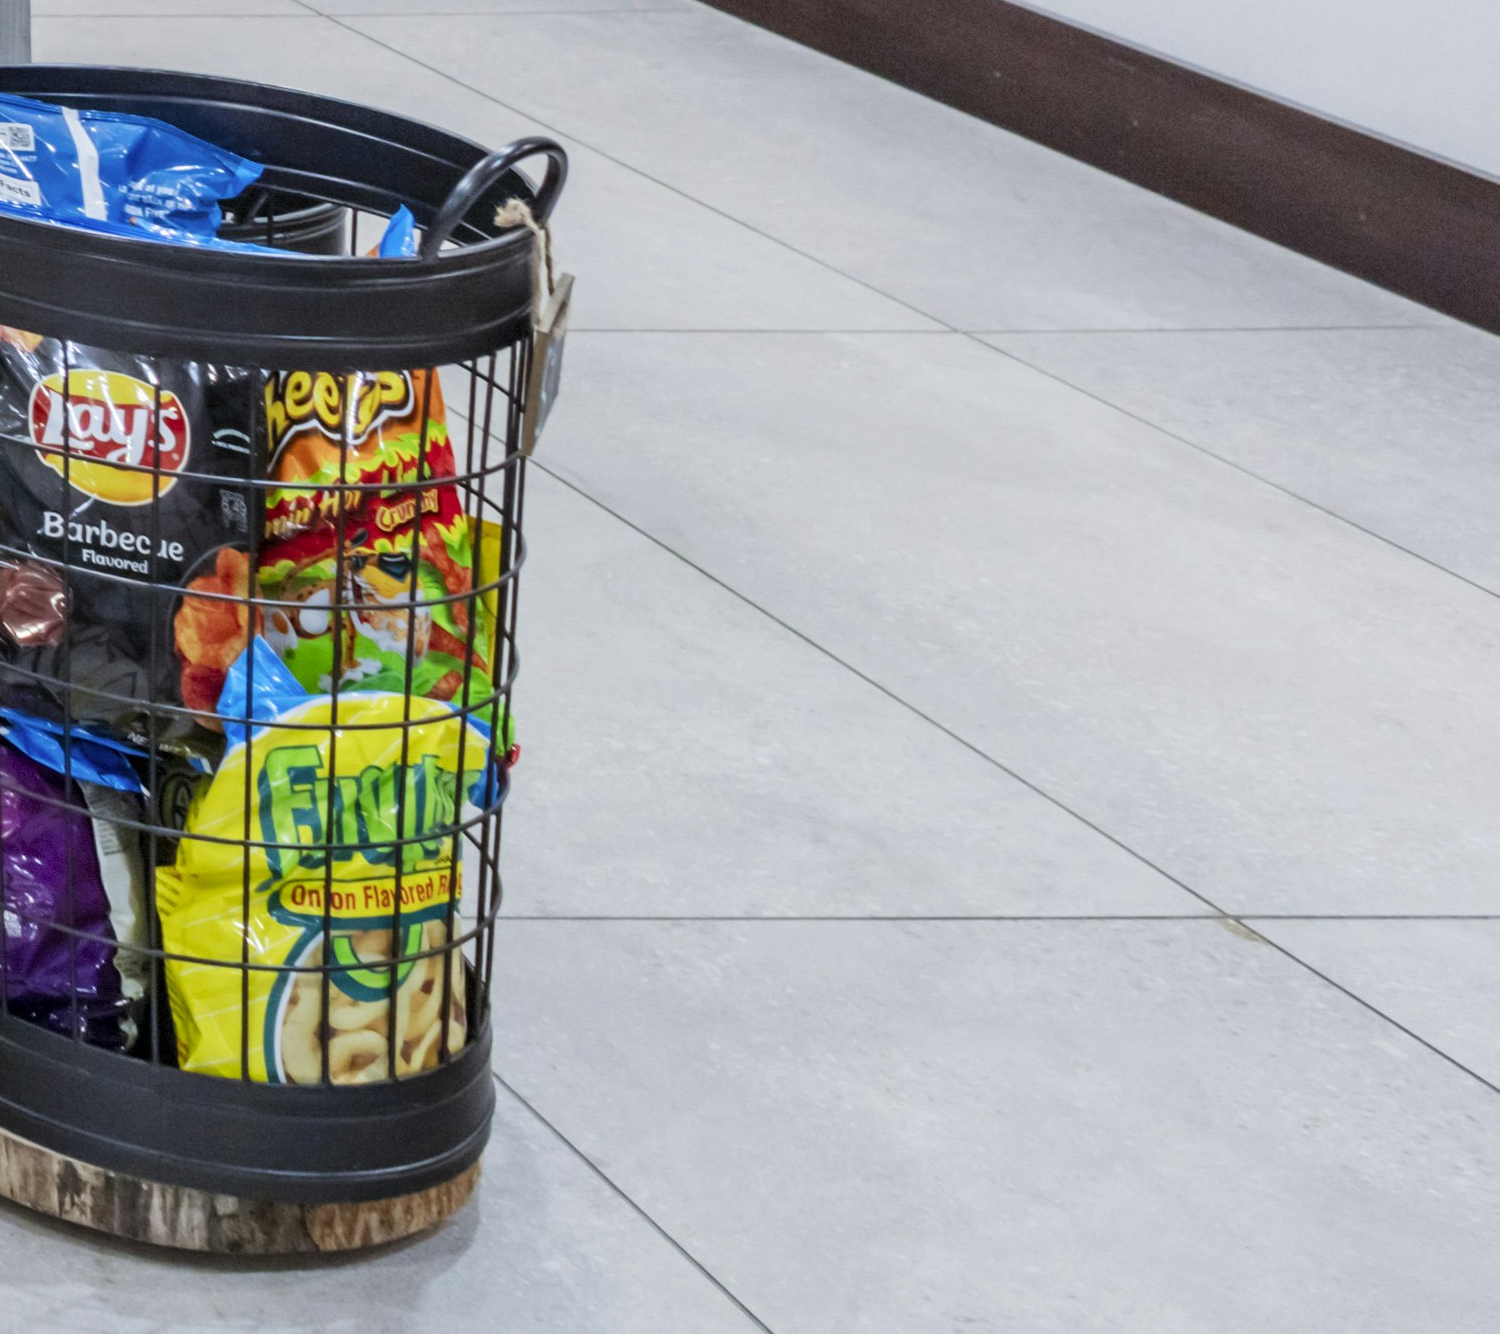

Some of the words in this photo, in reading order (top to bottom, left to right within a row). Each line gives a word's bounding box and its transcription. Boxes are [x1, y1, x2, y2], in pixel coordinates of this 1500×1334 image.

[0, 181, 32, 198] Facts
[39, 394, 178, 469] Lay's
[81, 546, 150, 576] Flavored
